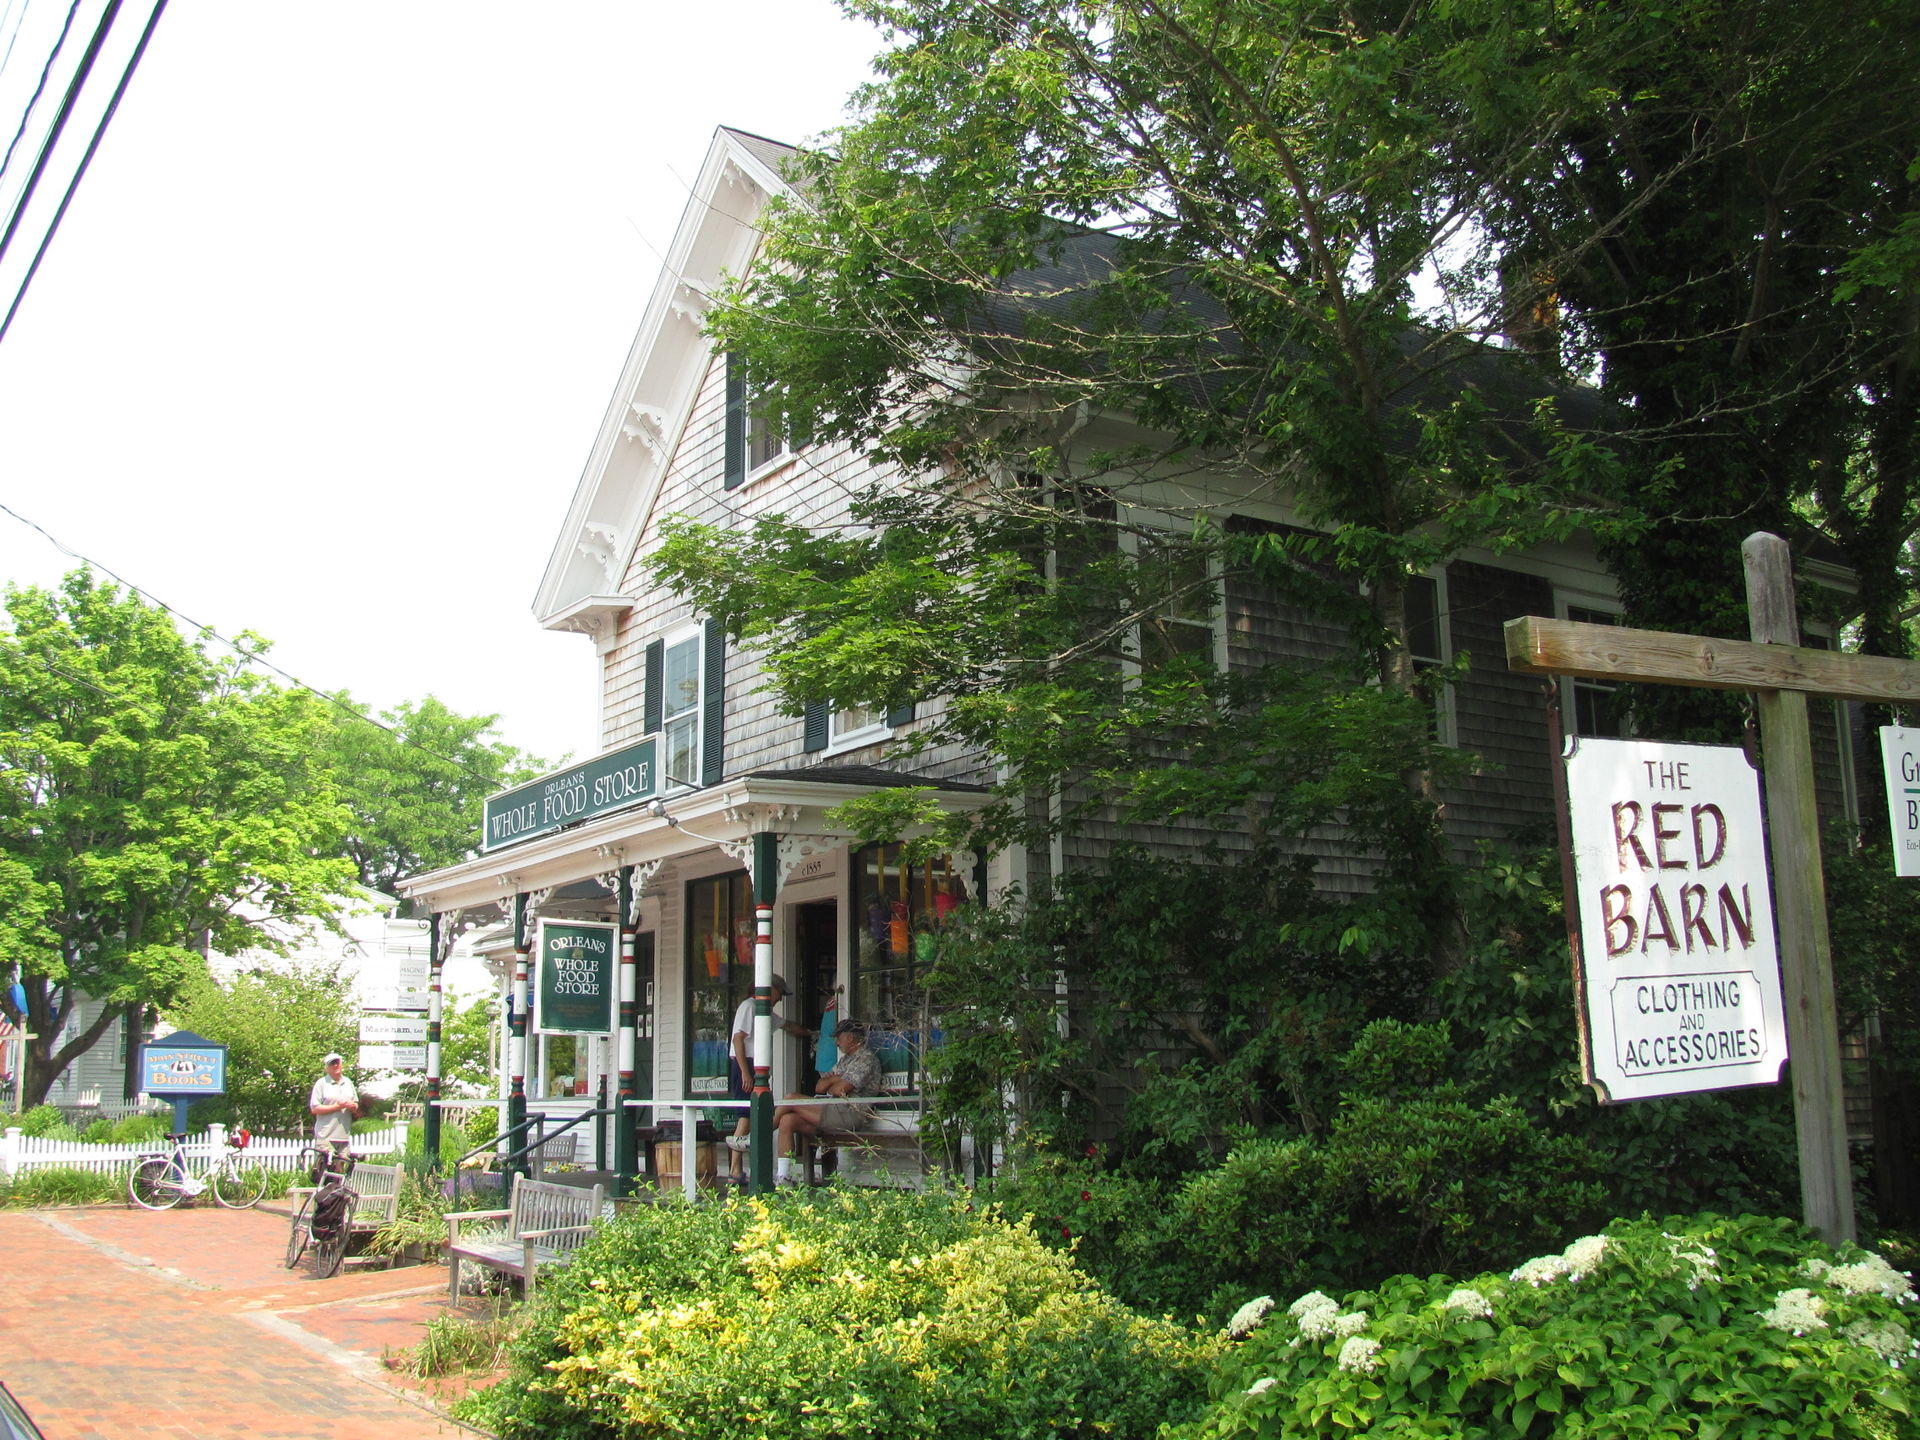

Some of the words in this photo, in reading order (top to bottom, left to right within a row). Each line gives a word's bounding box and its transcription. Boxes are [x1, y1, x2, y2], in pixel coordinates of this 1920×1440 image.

[544, 771, 585, 795] ORLEANS
[1643, 760, 1692, 791] THE
[491, 801, 537, 840] WHOLE
[543, 784, 588, 824] FOOD
[593, 761, 649, 806] STORE
[1611, 800, 1728, 873] RED
[1600, 881, 1756, 961] BARN
[550, 936, 606, 954] ORLEANS
[554, 958, 599, 972] WHOLE
[558, 970, 596, 983] FOOD
[554, 982, 600, 995] STORE
[1636, 980, 1741, 1014] CLOTHING
[1679, 1013, 1706, 1031] AND
[1625, 1028, 1760, 1069] ACCESSORIES
